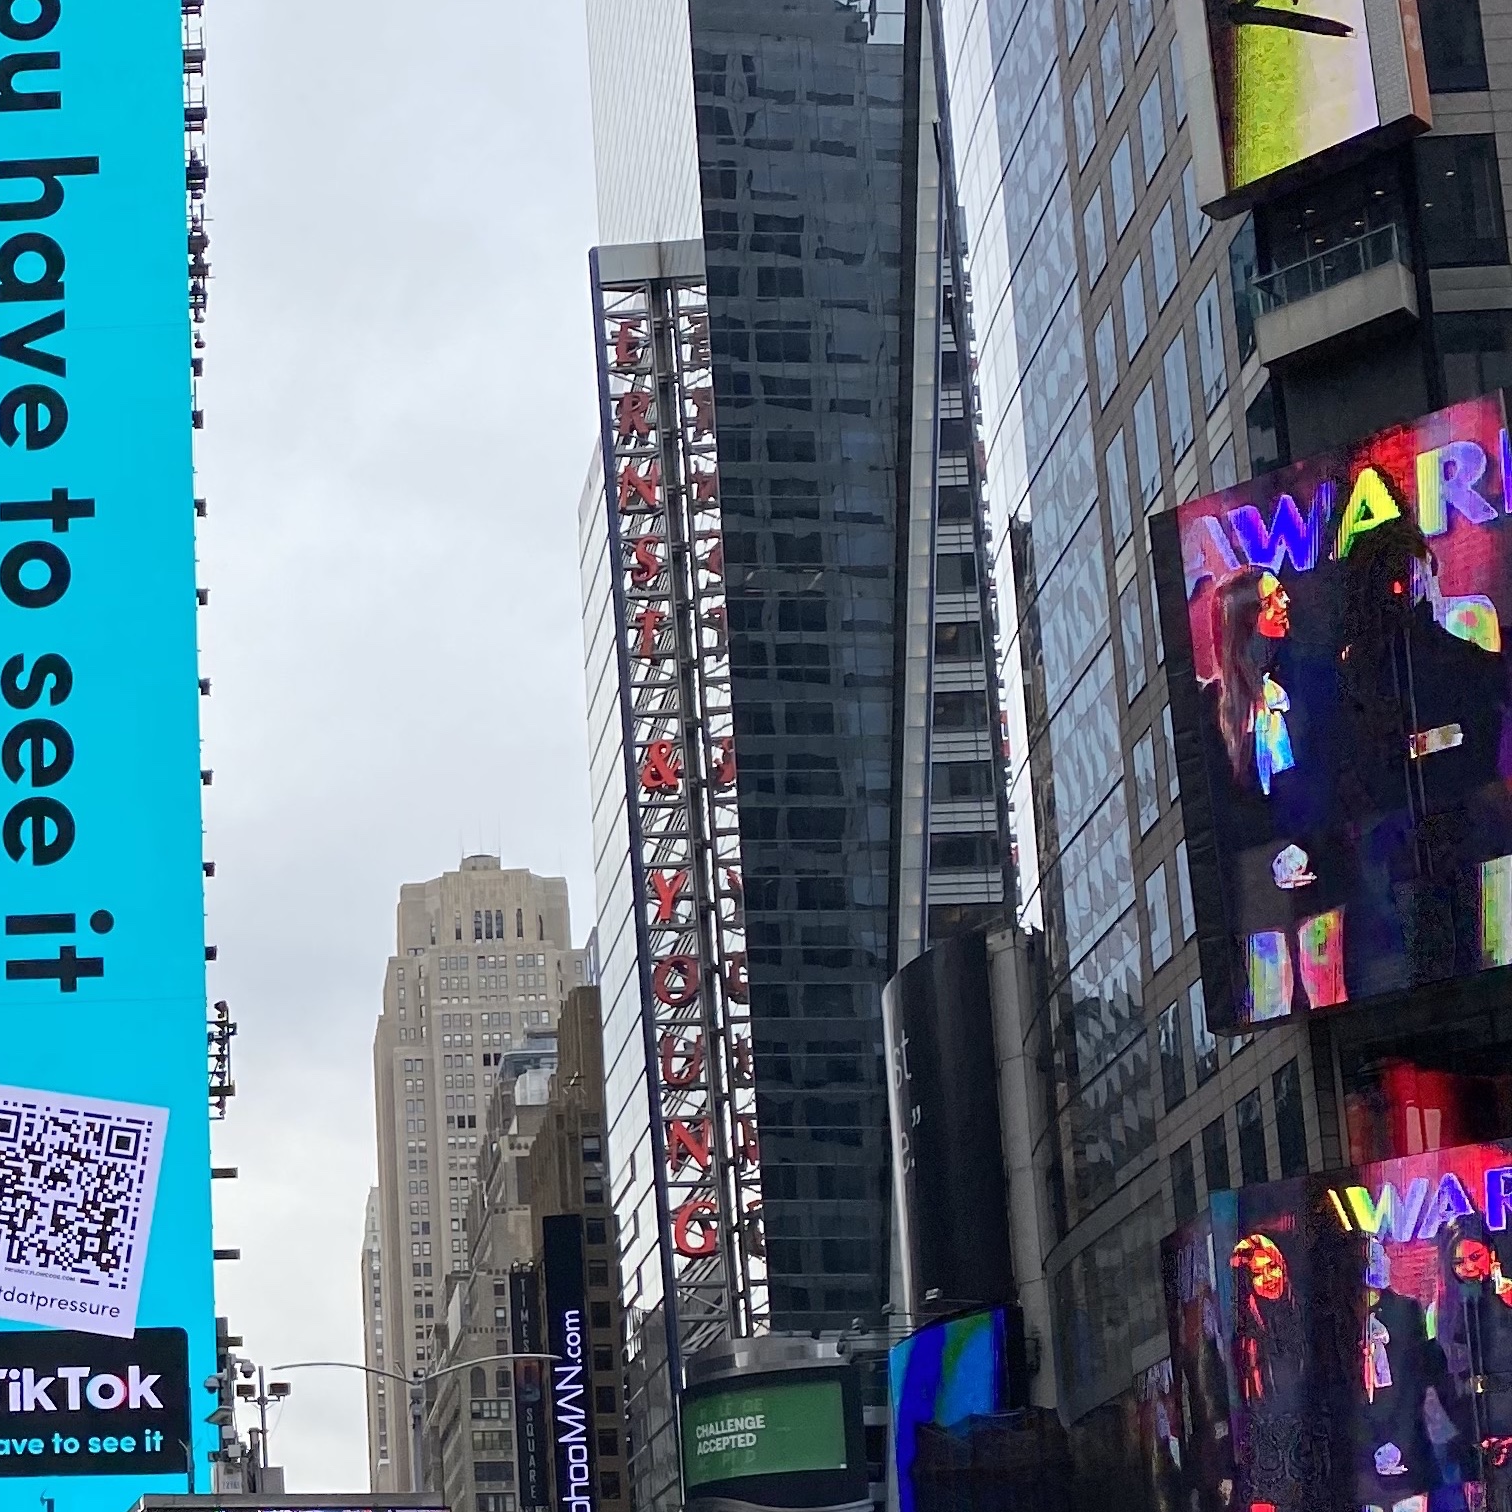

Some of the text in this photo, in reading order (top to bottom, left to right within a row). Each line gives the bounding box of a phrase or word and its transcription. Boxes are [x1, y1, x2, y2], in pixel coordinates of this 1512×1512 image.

[0, 487, 95, 609] to
[0, 652, 76, 866] see
[615, 321, 717, 1257] ERNST & YOUNG
[4, 908, 115, 993] it
[520, 1278, 536, 1500] TIMES SQUARE
[695, 1414, 766, 1439] CHALLENGE
[52, 1431, 81, 1455] to
[88, 1433, 136, 1454] see
[145, 1428, 164, 1453] it
[696, 1432, 758, 1456] ACCEPTED
